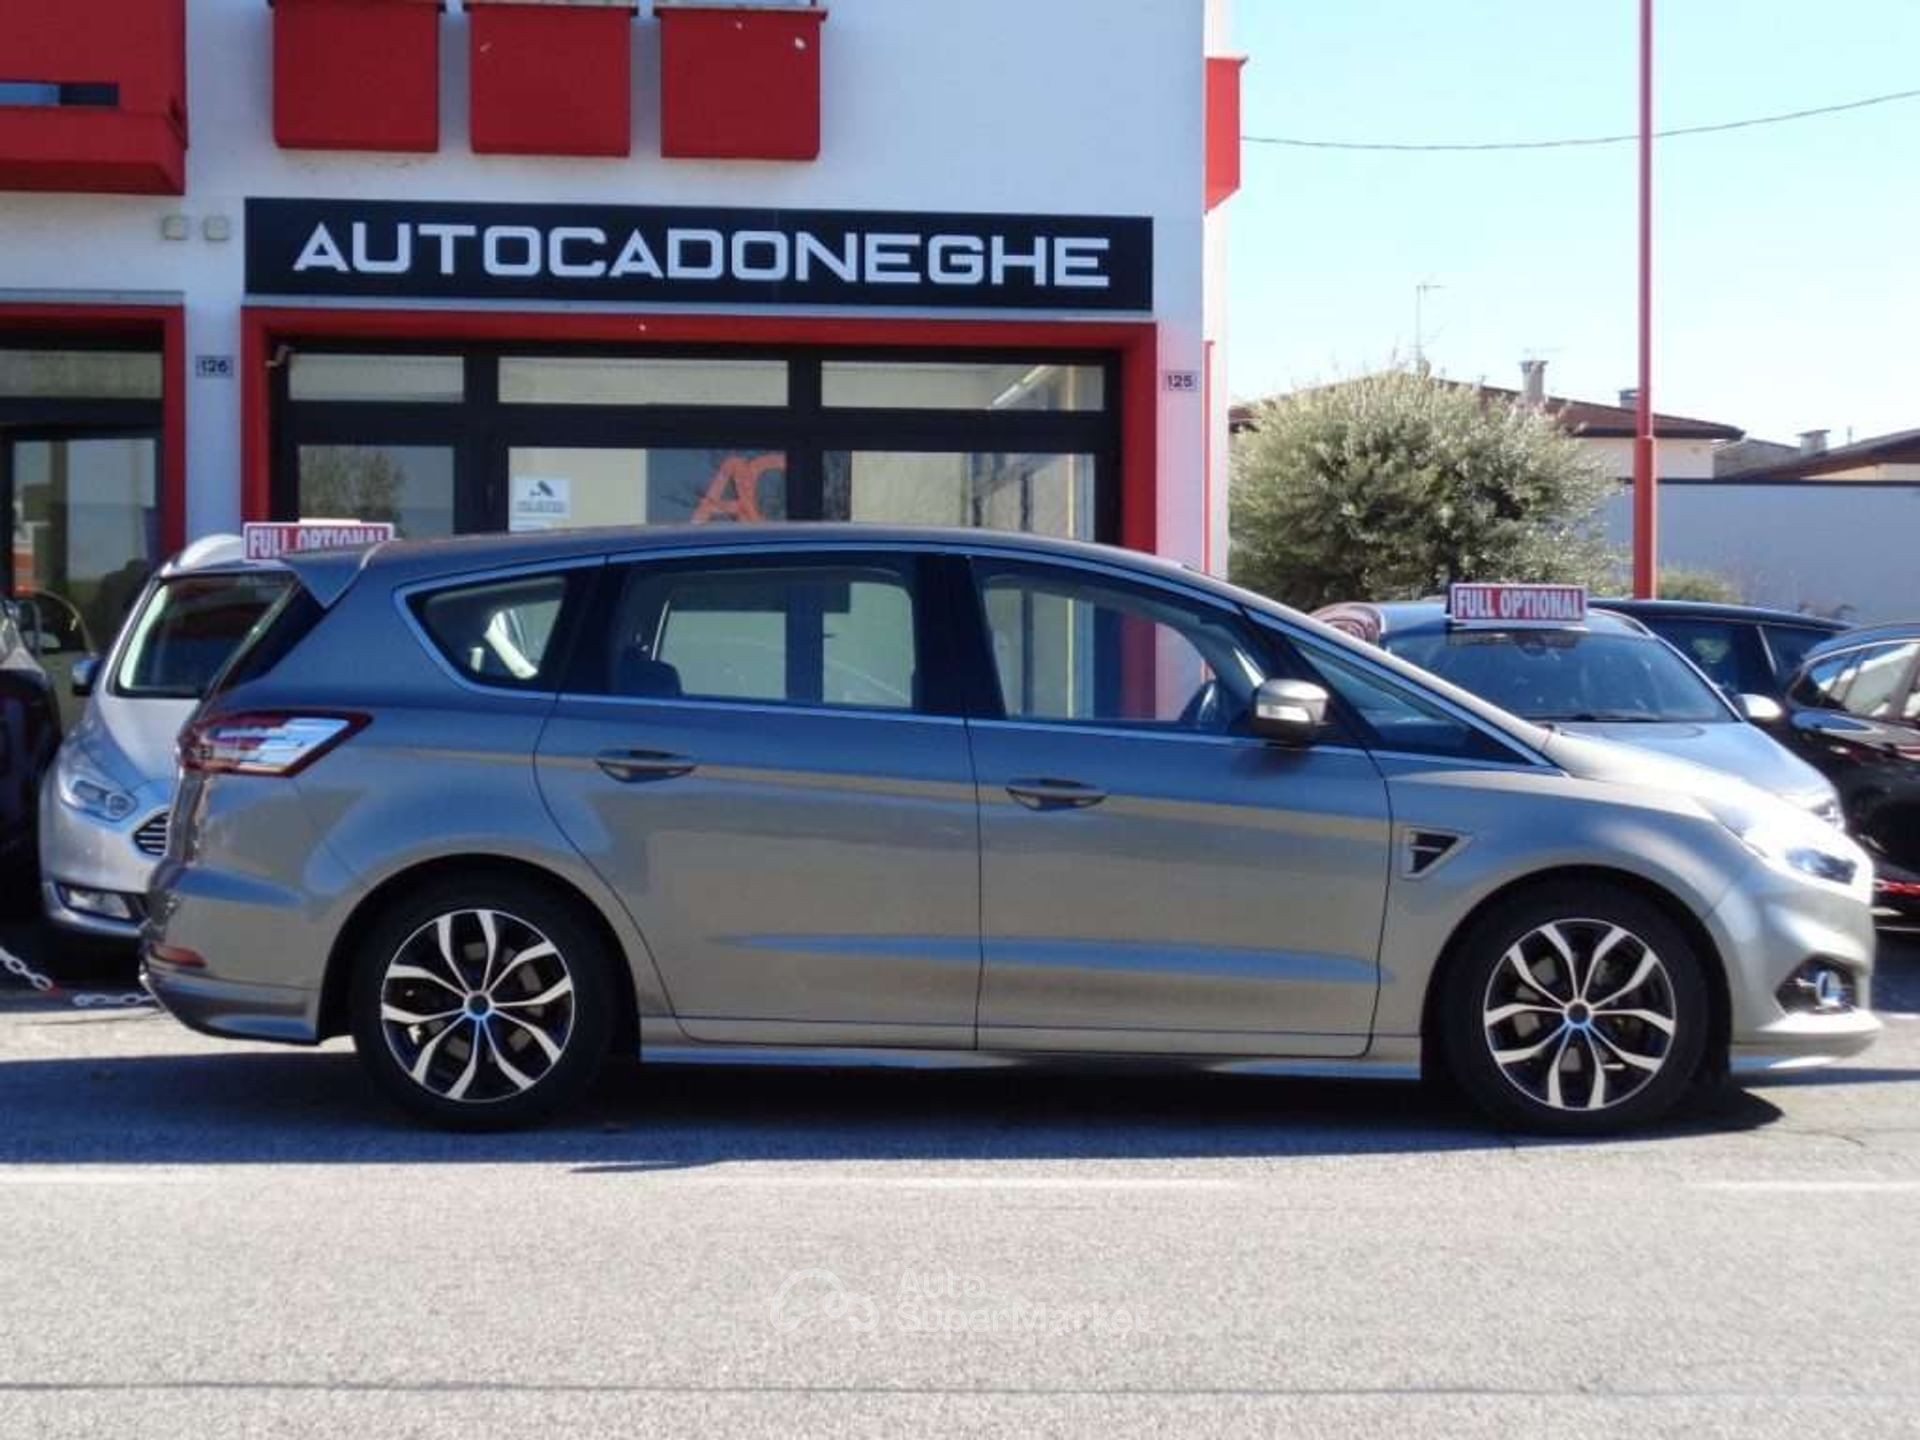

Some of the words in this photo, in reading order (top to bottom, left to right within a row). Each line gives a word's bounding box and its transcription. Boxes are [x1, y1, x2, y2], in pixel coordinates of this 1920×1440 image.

[293, 221, 1111, 289] AUTOCADONEGHE
[201, 359, 227, 374] 126
[1167, 374, 1193, 389] 125
[250, 528, 292, 558] FULL
[1457, 588, 1497, 618] FULL
[1499, 590, 1582, 619] OPTIONAL
